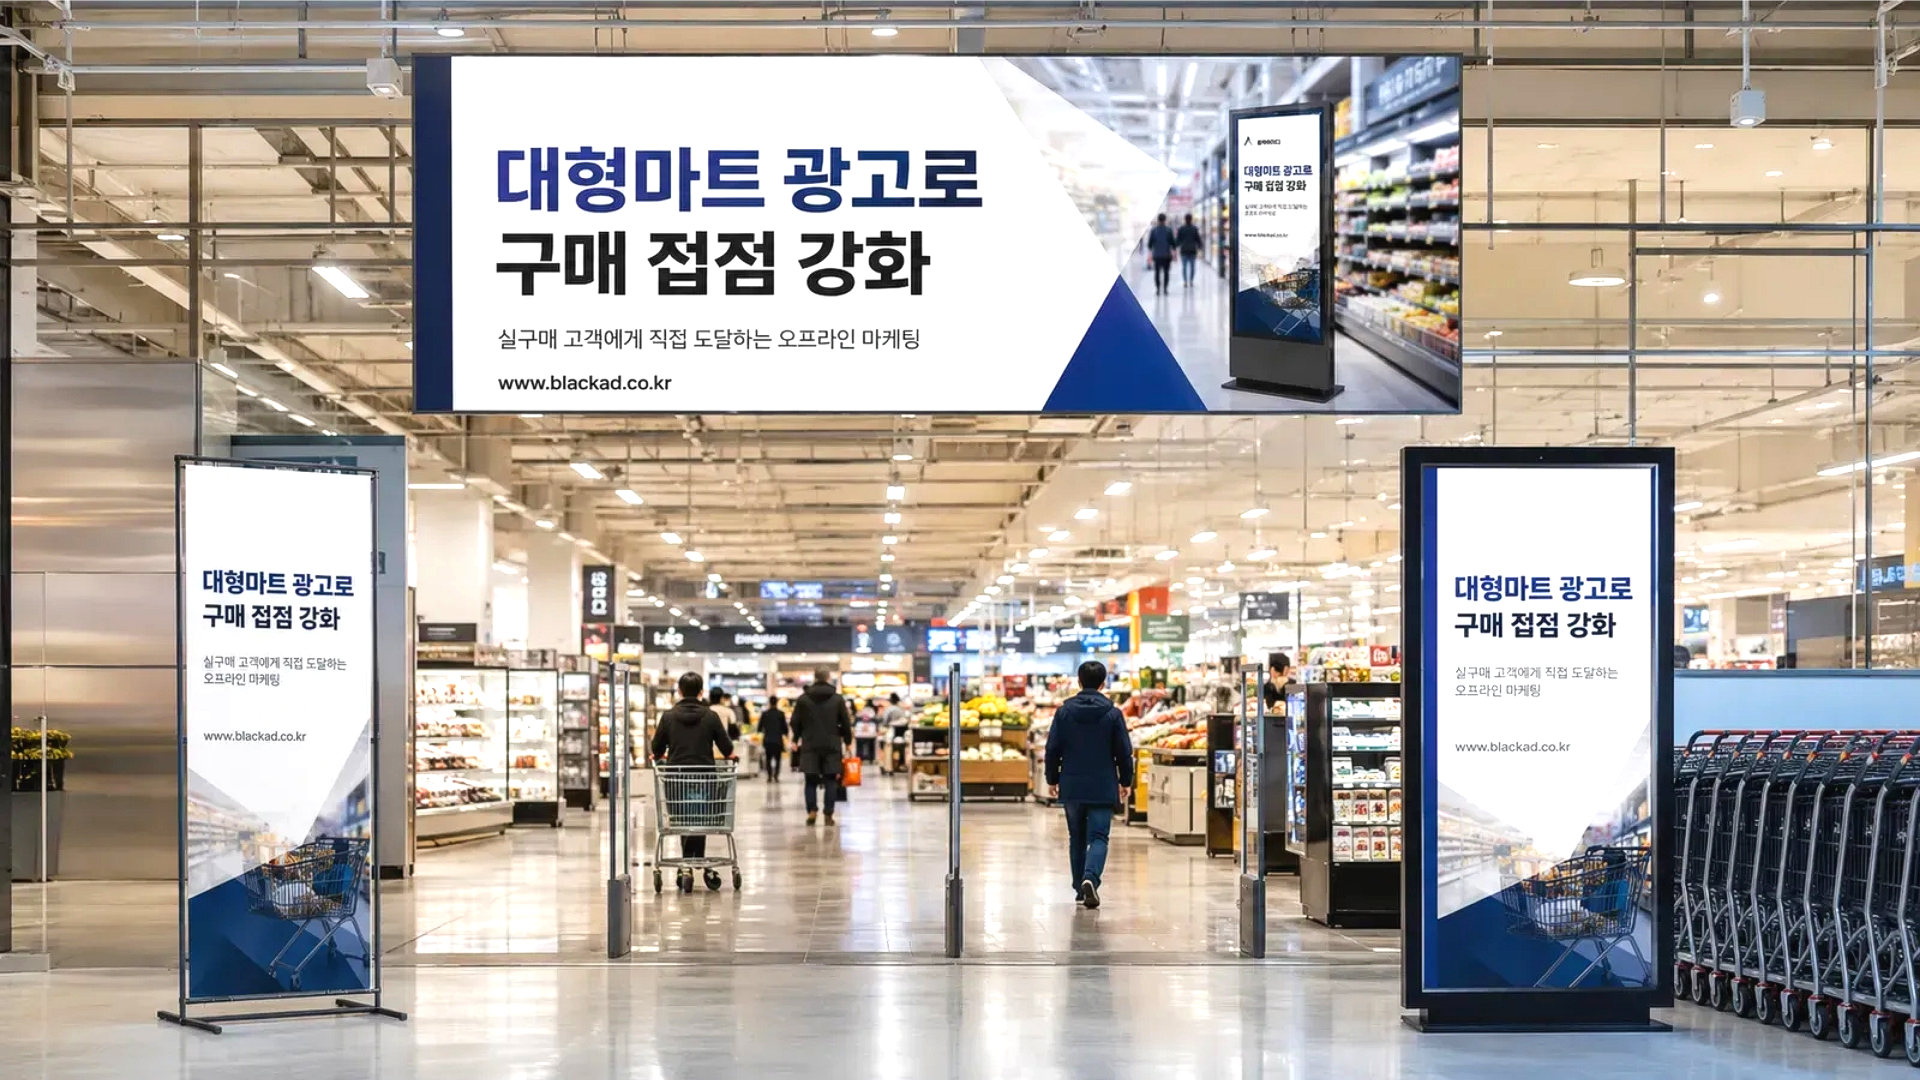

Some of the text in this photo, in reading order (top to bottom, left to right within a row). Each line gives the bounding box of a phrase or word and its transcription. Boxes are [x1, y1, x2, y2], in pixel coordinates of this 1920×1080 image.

[498, 146, 982, 213] 대형마트 광고로
[496, 231, 930, 296] 구매 접점 강화
[498, 328, 920, 350] 실구매 고객에게 직접 도달하는 오프라인 마케팅
[498, 374, 672, 391] www.blackad.co.kr
[203, 570, 354, 596] 대형마트 광고로
[1455, 575, 1633, 602] 대형마트 광고로
[203, 604, 340, 630] 구매 접점 강화
[1455, 612, 1616, 638] 구매 접점 강화
[203, 656, 347, 671] 실구매 고객에게 직접 도달하는
[1455, 666, 1618, 680] 실구매 고객에게 직접 도달하는
[203, 673, 280, 687] 오프라인 마케팅
[1455, 684, 1541, 697] 오프라인 마케팅
[204, 731, 306, 742] www.blackad.co.kr
[1455, 742, 1571, 753] www.blackad.co.kr
